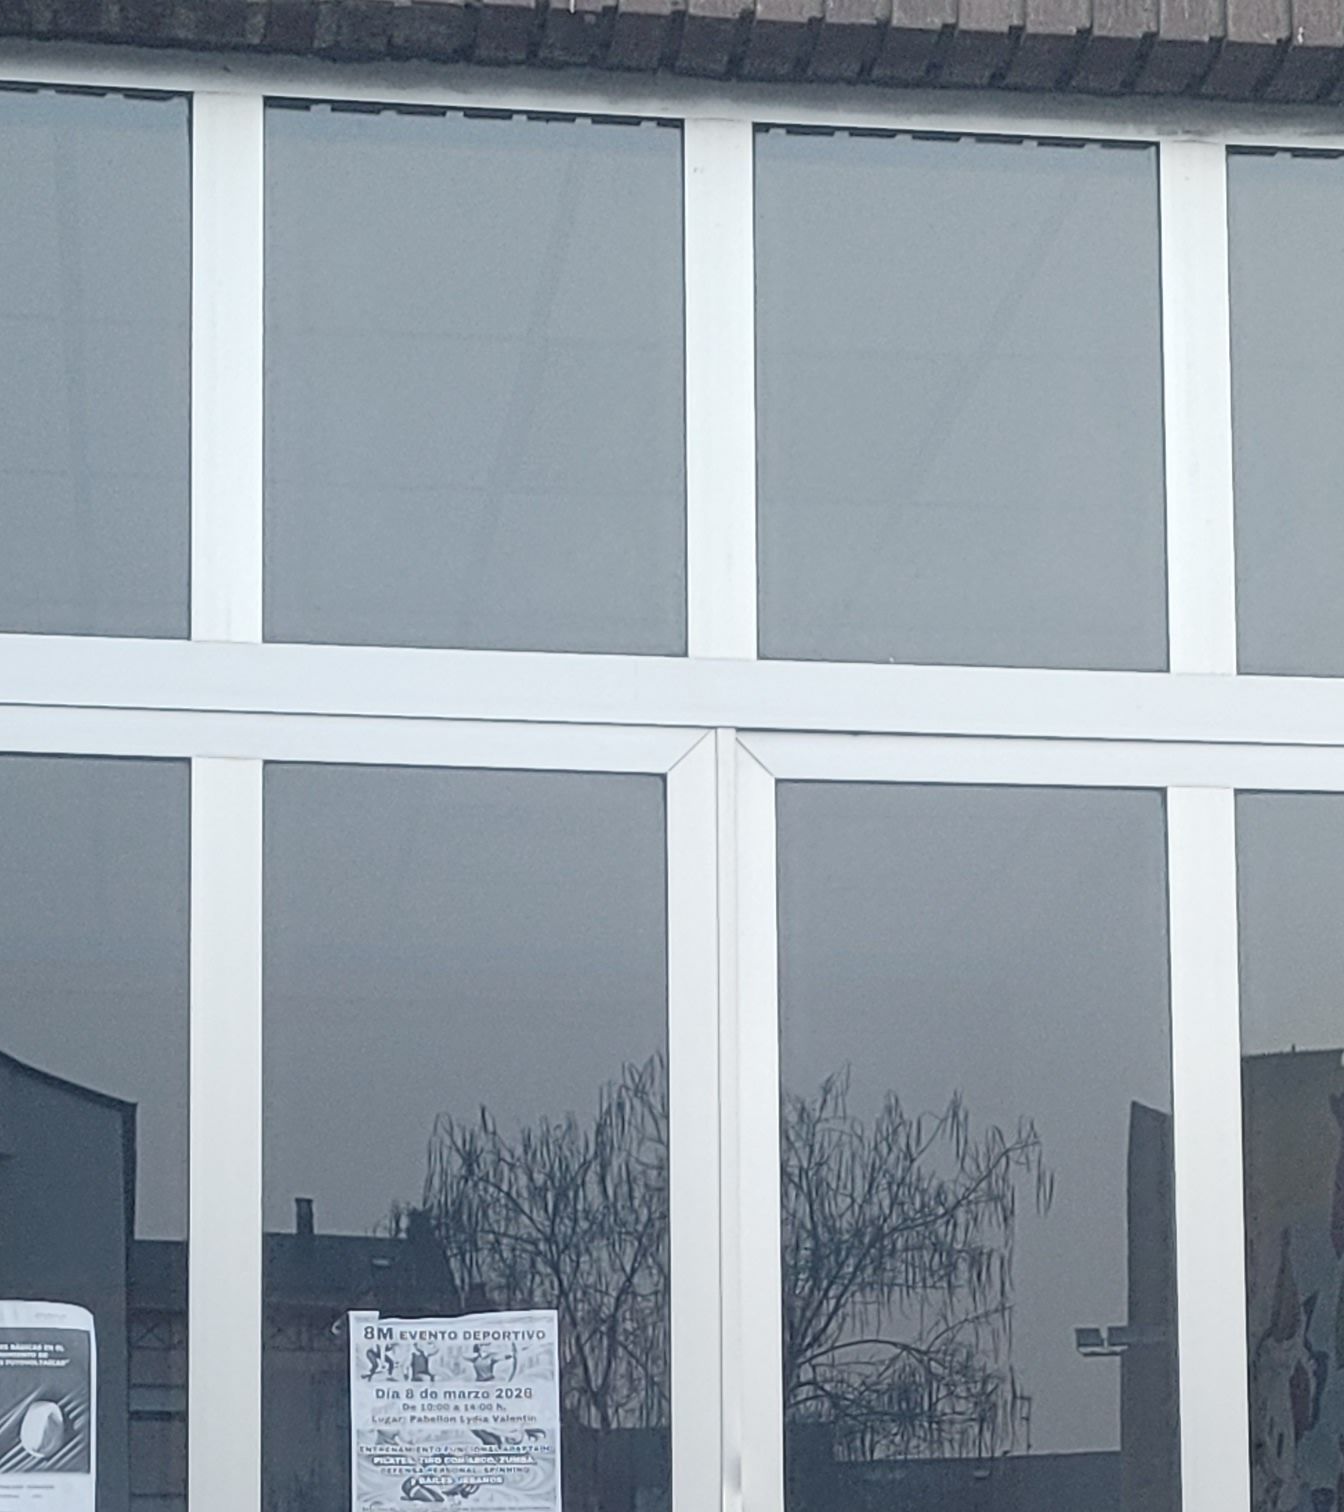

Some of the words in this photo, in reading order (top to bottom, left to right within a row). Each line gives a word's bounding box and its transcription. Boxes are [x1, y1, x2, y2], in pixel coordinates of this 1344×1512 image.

[363, 1326, 393, 1340] 8M
[399, 1330, 457, 1340] EVENTO
[463, 1330, 546, 1340] DEPORTIVO
[375, 1388, 400, 1399] Día
[405, 1388, 414, 1399] 8
[420, 1388, 437, 1399] de
[443, 1390, 489, 1399] marzo
[402, 1403, 417, 1411] De
